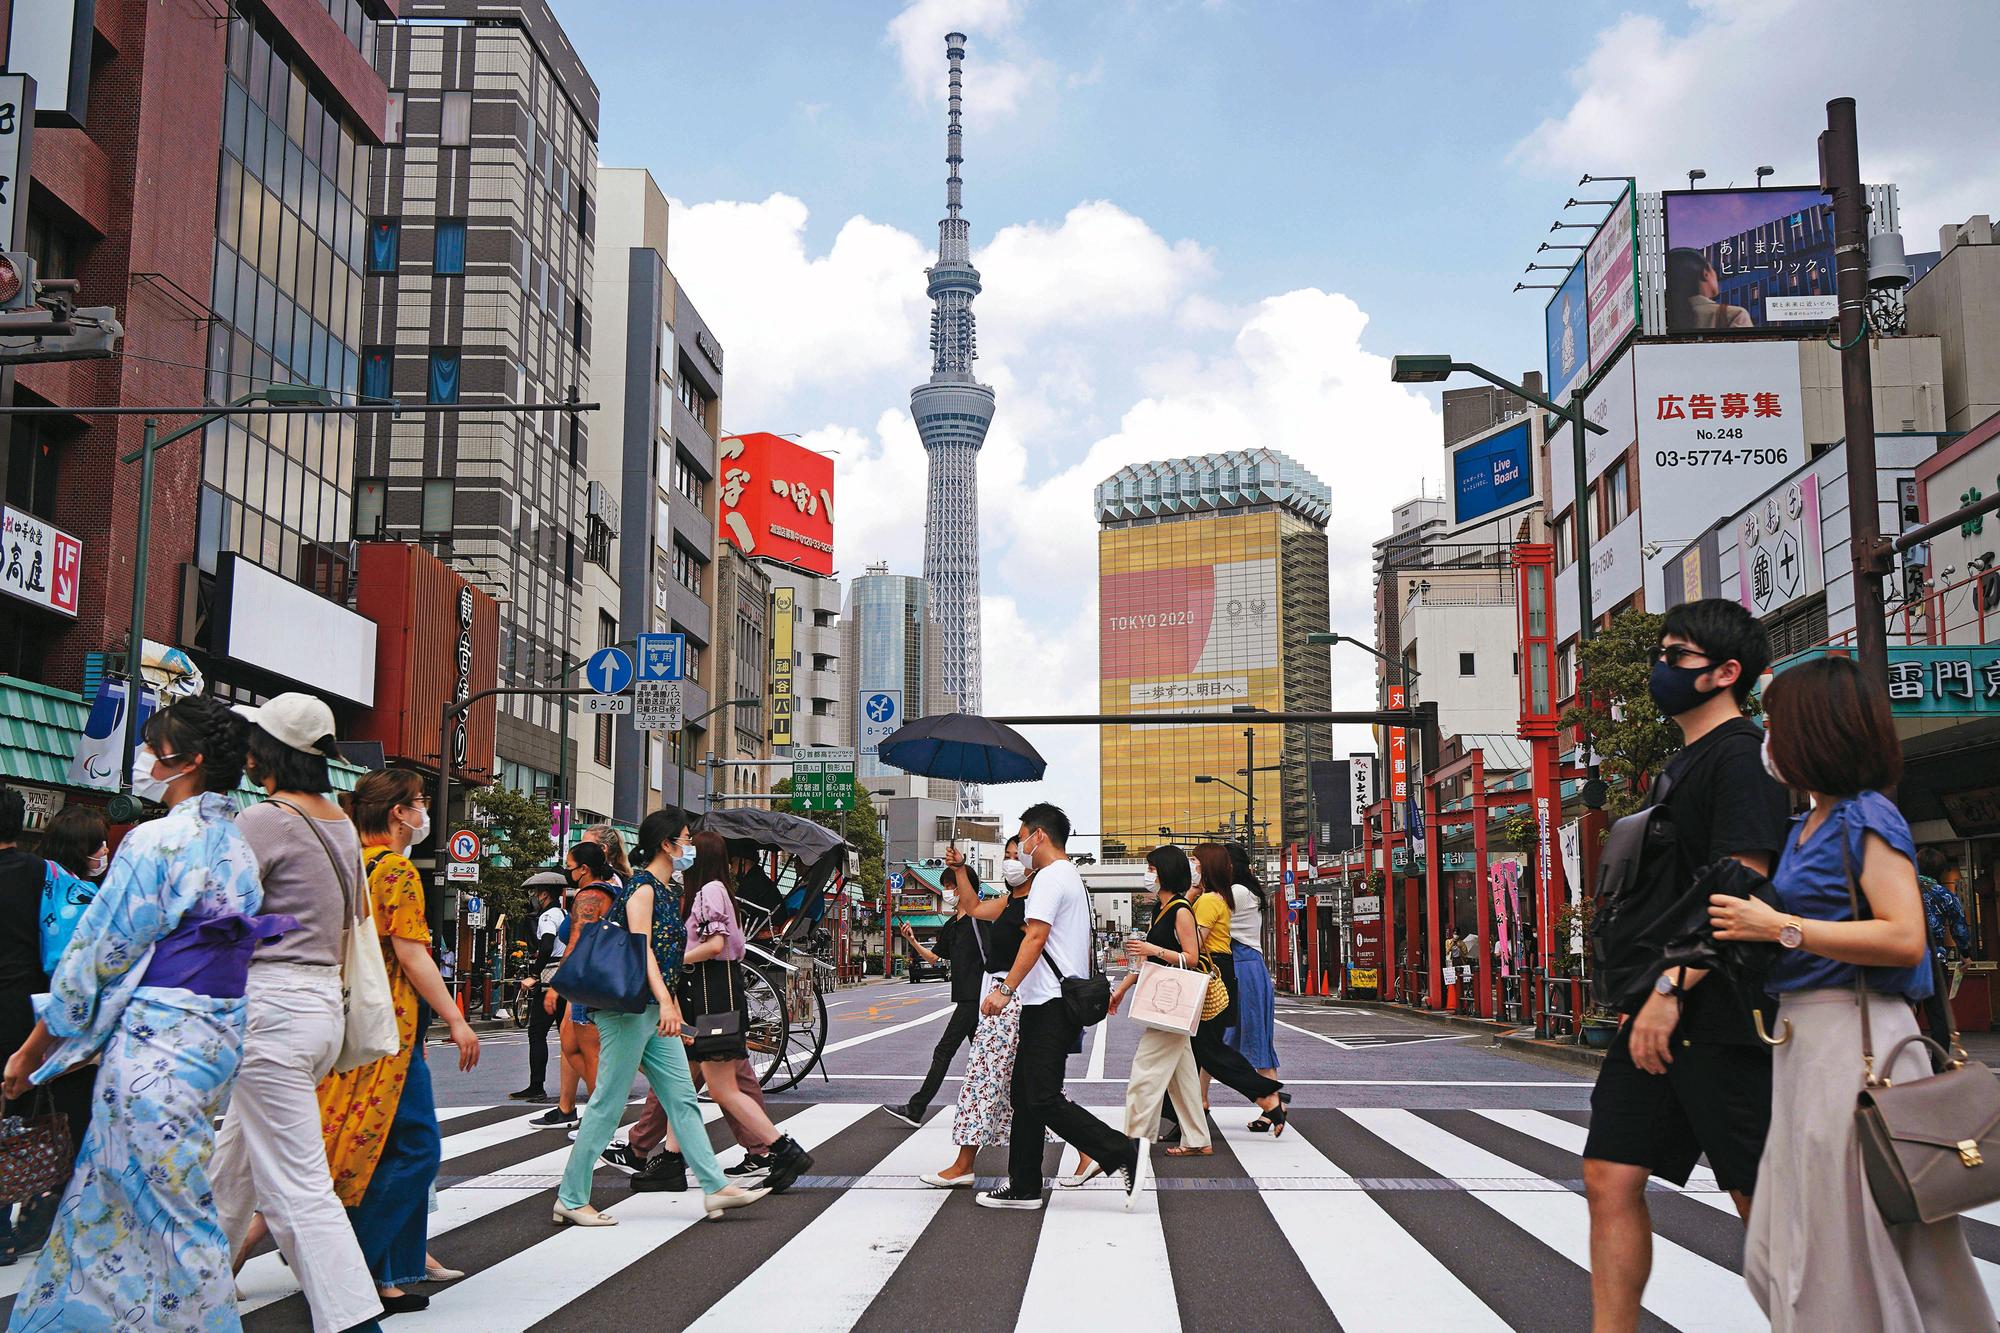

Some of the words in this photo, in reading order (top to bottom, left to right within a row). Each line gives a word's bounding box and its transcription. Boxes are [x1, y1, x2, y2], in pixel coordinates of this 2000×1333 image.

[1721, 259, 1827, 275] ヒューリック。
[1656, 392, 1782, 420] 広告募集
[1493, 459, 1511, 473] Live
[1655, 448, 1788, 467] 03-5774-7506
[1494, 466, 1519, 486] Board
[57, 541, 77, 572] 1F
[0, 540, 46, 593] 高屋
[1109, 614, 1157, 631] TOKYO
[1159, 610, 1194, 627] 2020
[649, 653, 672, 663] 専用
[775, 660, 790, 733] 神谷バー
[1138, 682, 1242, 700] 一歩ずつ、明日へ。
[797, 750, 803, 758] 6
[1391, 692, 1407, 797] 丸不動産
[28, 792, 48, 804] WINE
